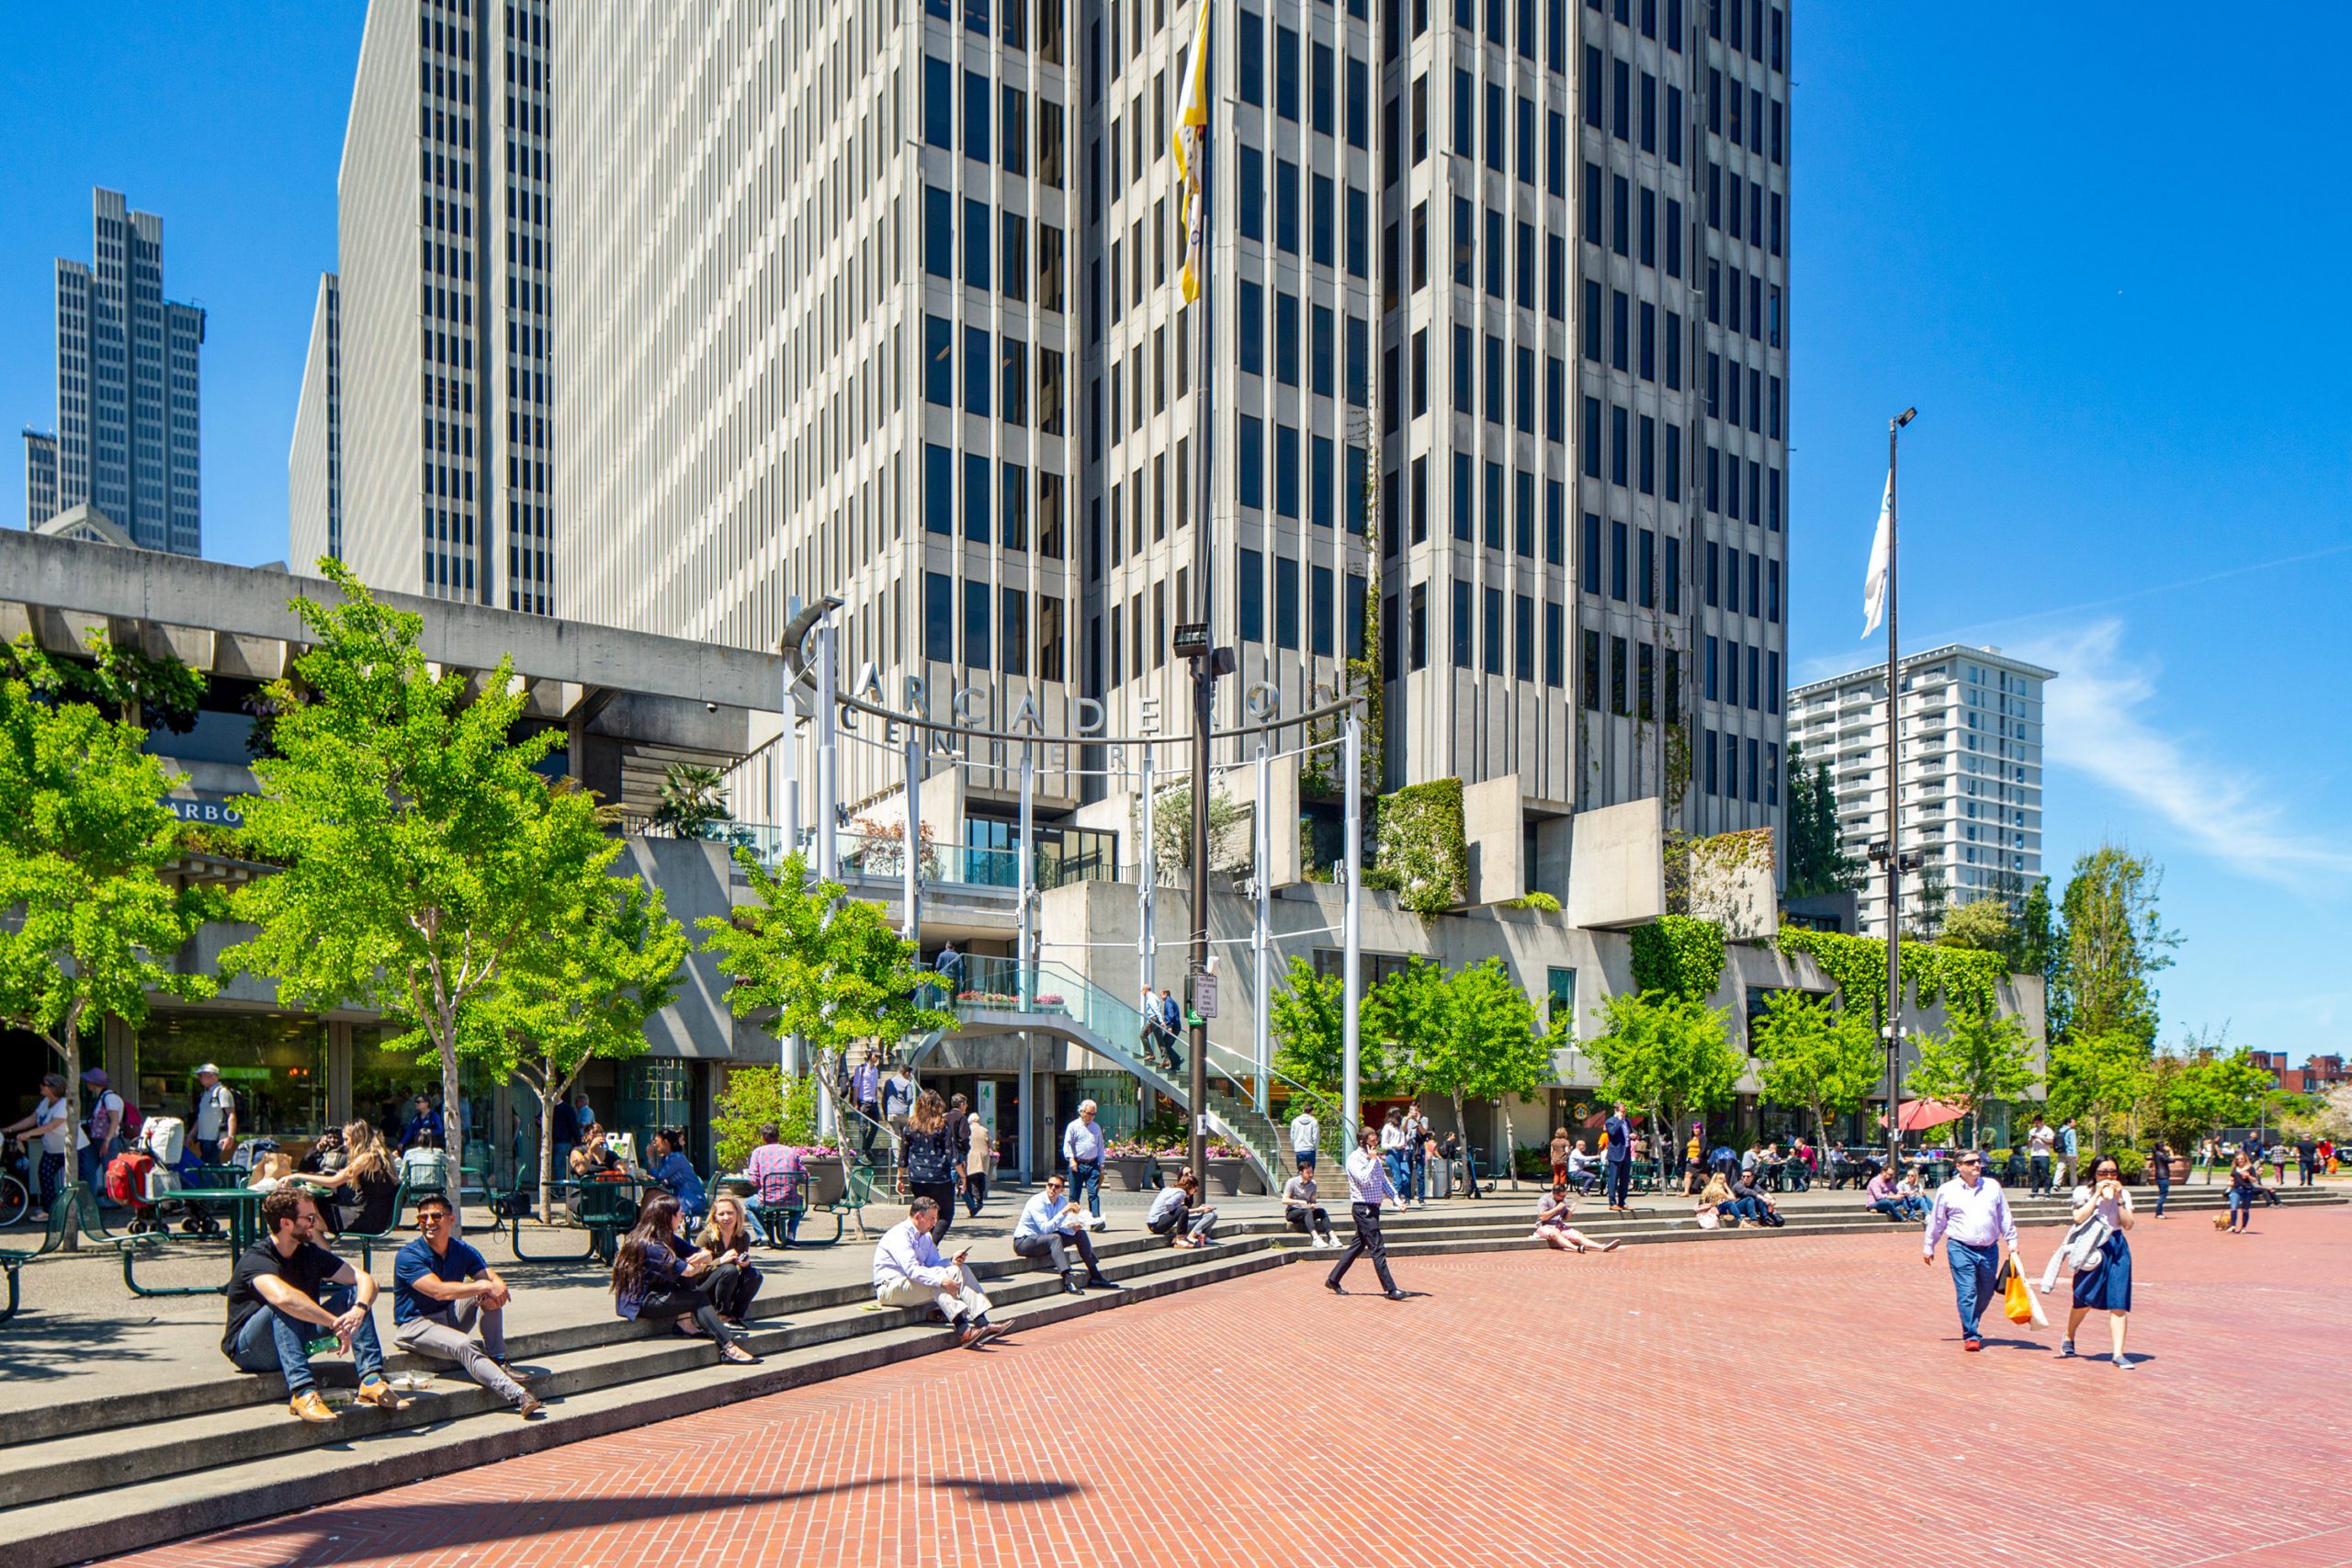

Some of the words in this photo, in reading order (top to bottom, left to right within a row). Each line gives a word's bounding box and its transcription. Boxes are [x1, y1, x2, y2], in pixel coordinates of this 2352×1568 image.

[801, 626, 1280, 733] ARCADEO
[841, 705, 1126, 768] CENTER
[155, 802, 242, 823] ARBO
